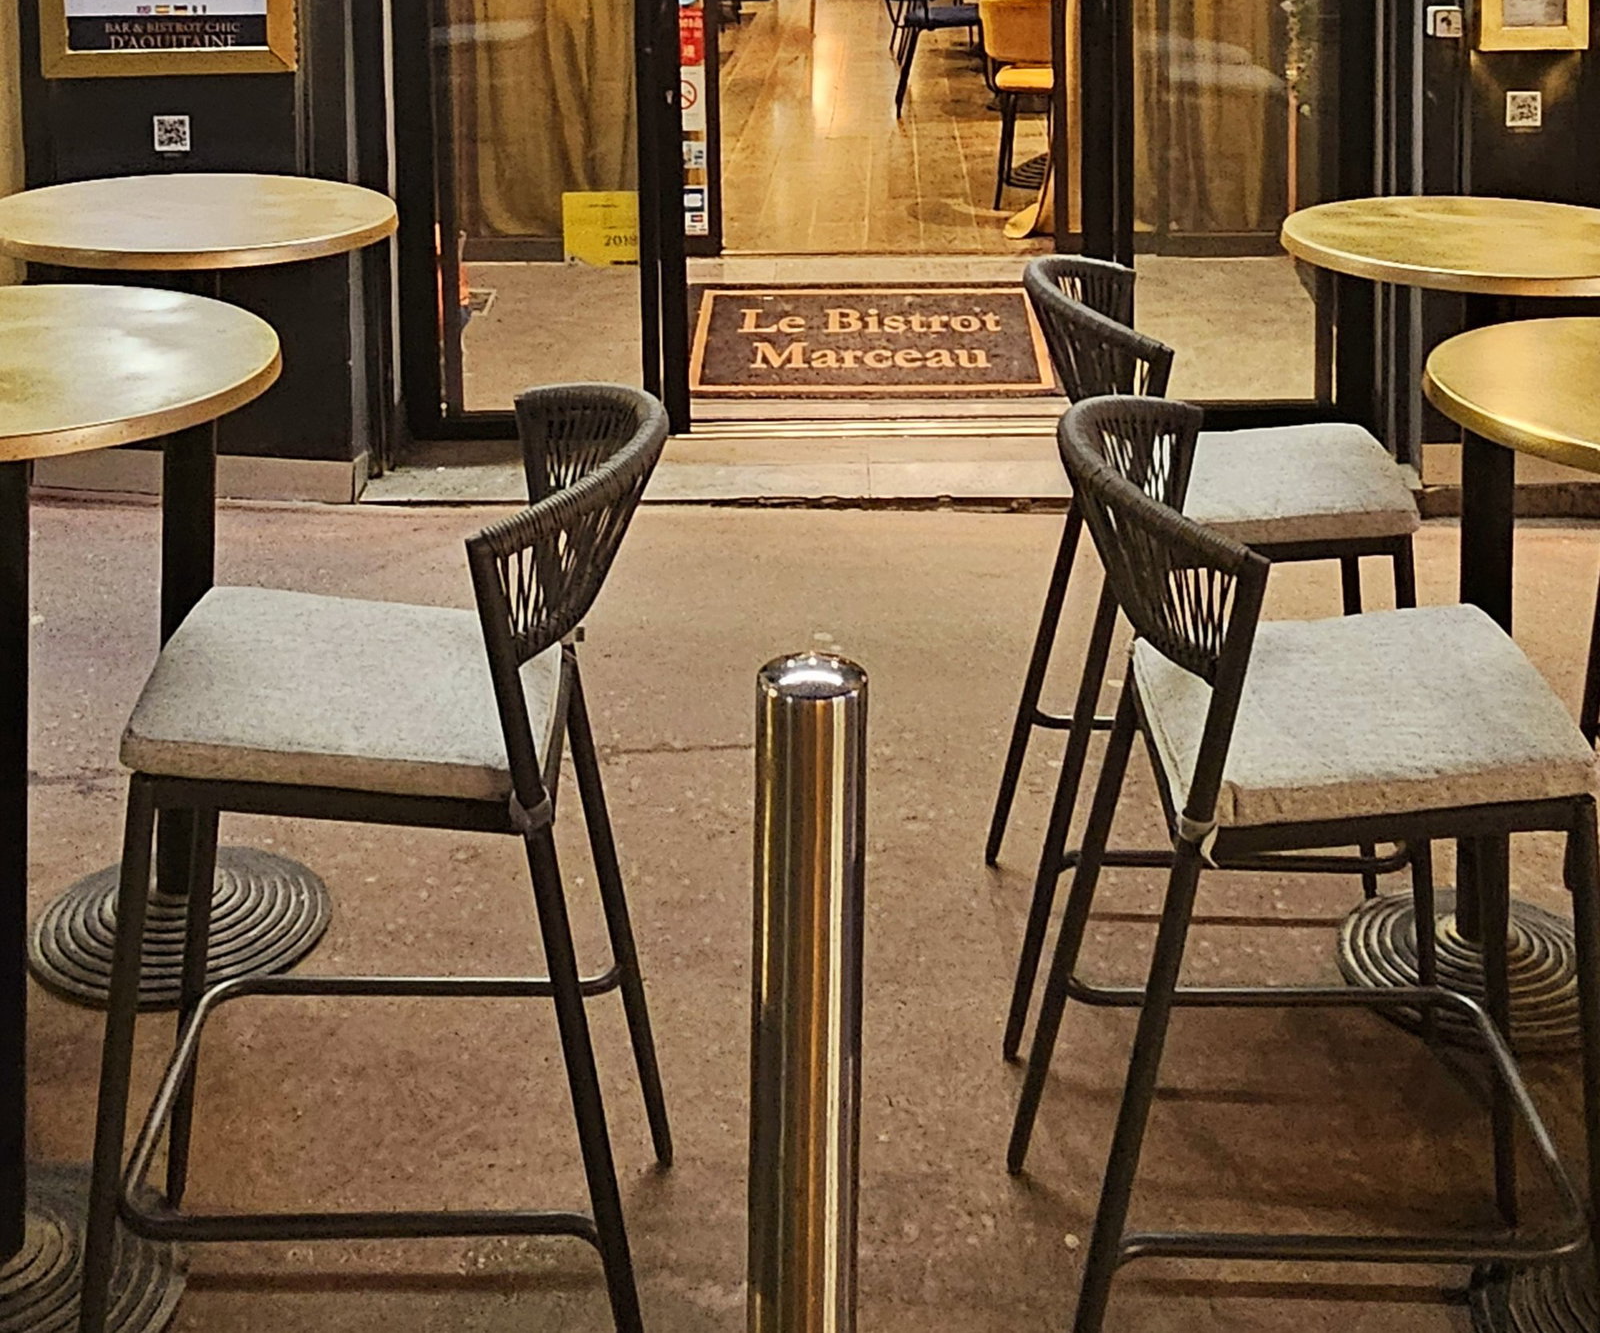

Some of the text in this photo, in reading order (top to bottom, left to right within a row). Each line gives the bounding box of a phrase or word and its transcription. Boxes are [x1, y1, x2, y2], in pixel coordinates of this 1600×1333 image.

[104, 22, 131, 34] BAR
[146, 21, 202, 34] BISTROT
[204, 21, 242, 33] CHIC
[737, 307, 1002, 335] Le Bistrot
[749, 341, 992, 369] Marceau
